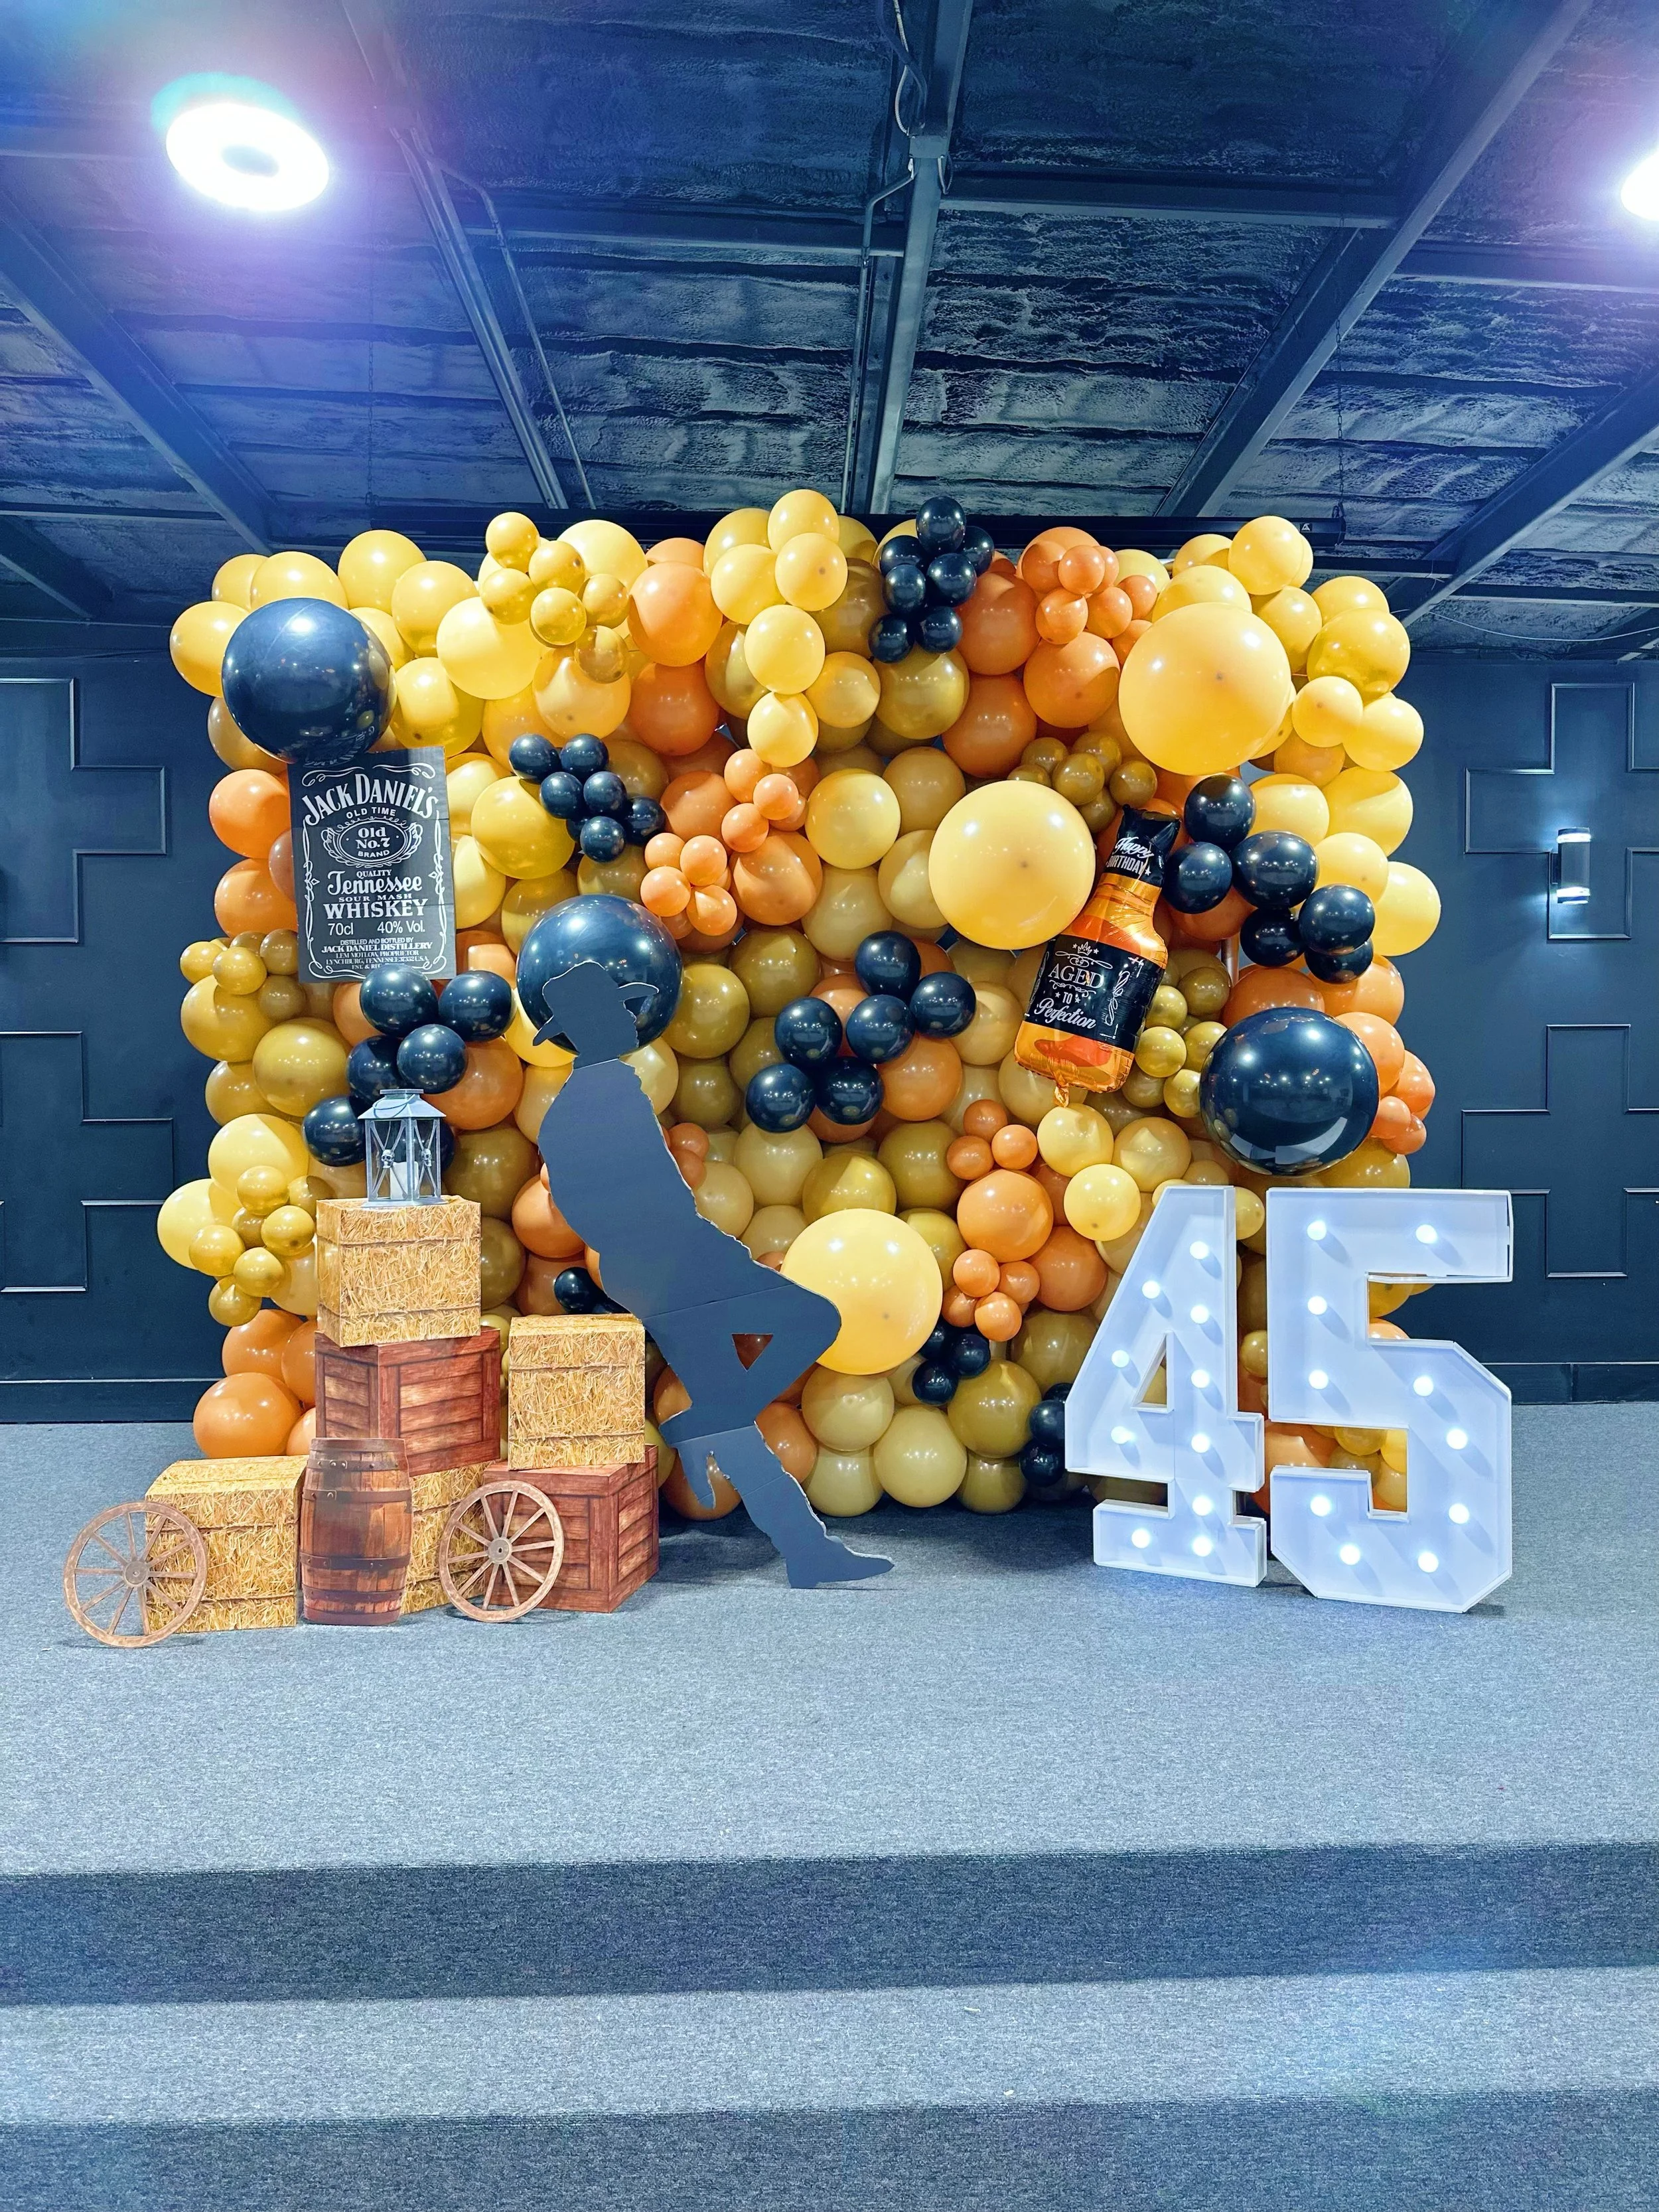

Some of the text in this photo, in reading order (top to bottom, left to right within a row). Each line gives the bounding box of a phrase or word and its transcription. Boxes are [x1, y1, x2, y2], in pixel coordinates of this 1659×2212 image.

[302, 774, 439, 826] JACK DANIEL'S
[346, 806, 396, 819] OLD TIME
[358, 827, 386, 838] Old
[1112, 836, 1155, 859] Happy
[356, 869, 392, 879] QUALITY
[1106, 855, 1146, 875] BIRTHDAY
[327, 871, 422, 895] Tennessee
[323, 898, 428, 919] WHISKEY
[328, 919, 425, 936] 70cl 40% Vol.
[346, 944, 380, 952] DANIEL
[380, 942, 433, 951] DISTILLERY
[1048, 963, 1104, 989] AGED
[1062, 992, 1073, 1004] TO
[1034, 997, 1096, 1029] Perfection
